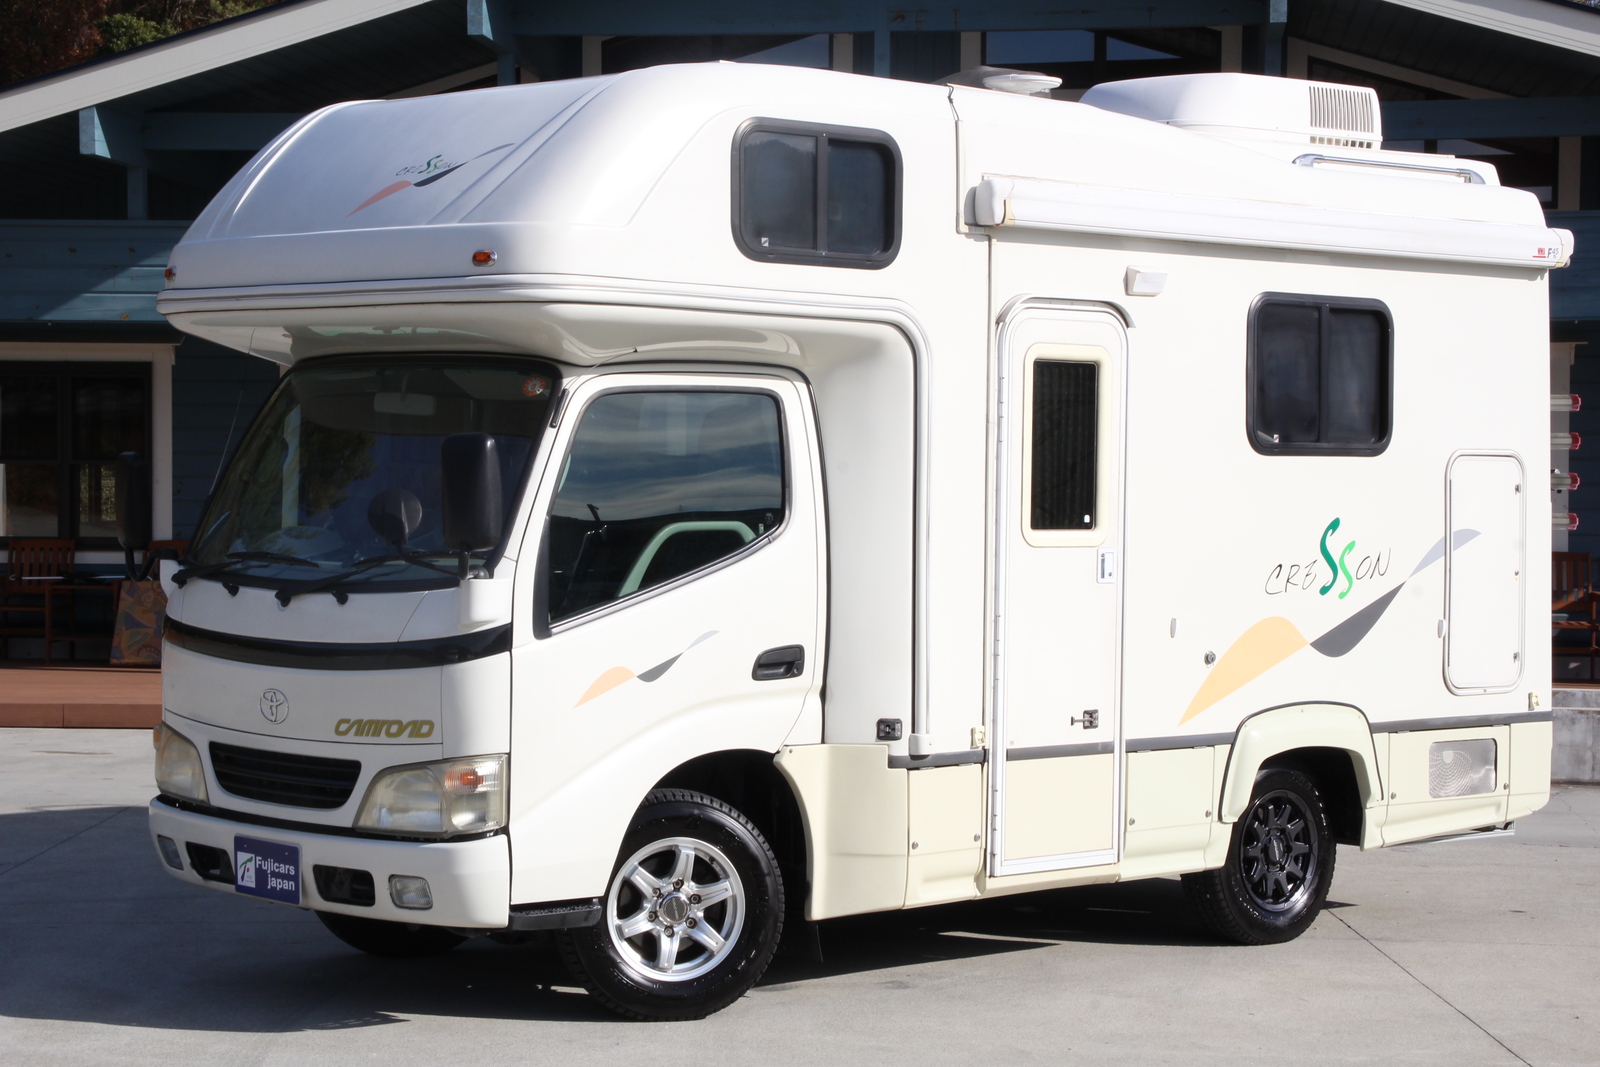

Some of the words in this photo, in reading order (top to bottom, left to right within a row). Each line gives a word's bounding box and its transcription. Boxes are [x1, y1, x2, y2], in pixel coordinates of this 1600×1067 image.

[396, 154, 458, 176] CRESSON
[1264, 517, 1391, 600] CRESSON
[334, 718, 435, 739] CAMROAD
[256, 856, 295, 876] Fujicars
[267, 874, 295, 891] japan
